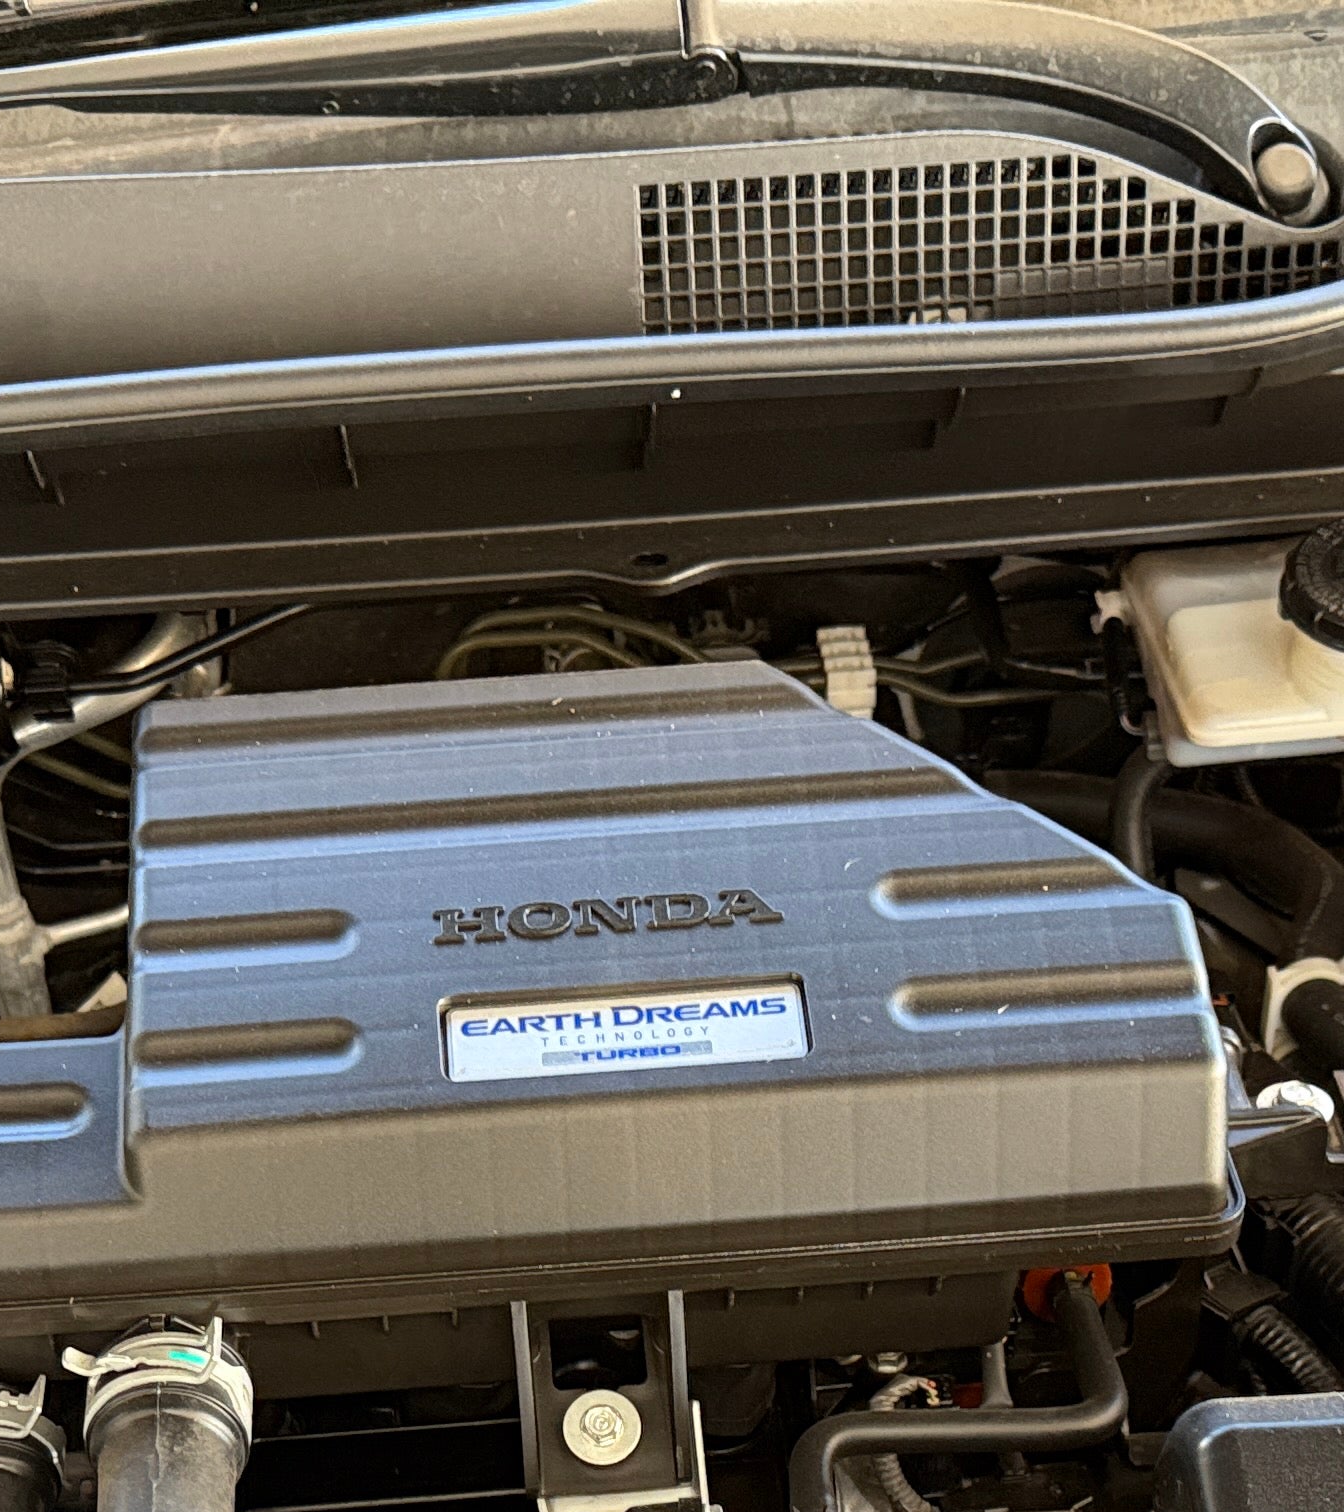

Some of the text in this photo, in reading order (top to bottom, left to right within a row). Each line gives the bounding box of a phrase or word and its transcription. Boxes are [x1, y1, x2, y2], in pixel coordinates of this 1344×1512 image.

[432, 889, 784, 945] HONDA
[461, 997, 787, 1038] EARTH DREAMS
[539, 1025, 711, 1048] TECHNOLOGY
[574, 1044, 682, 1062] TURBO
